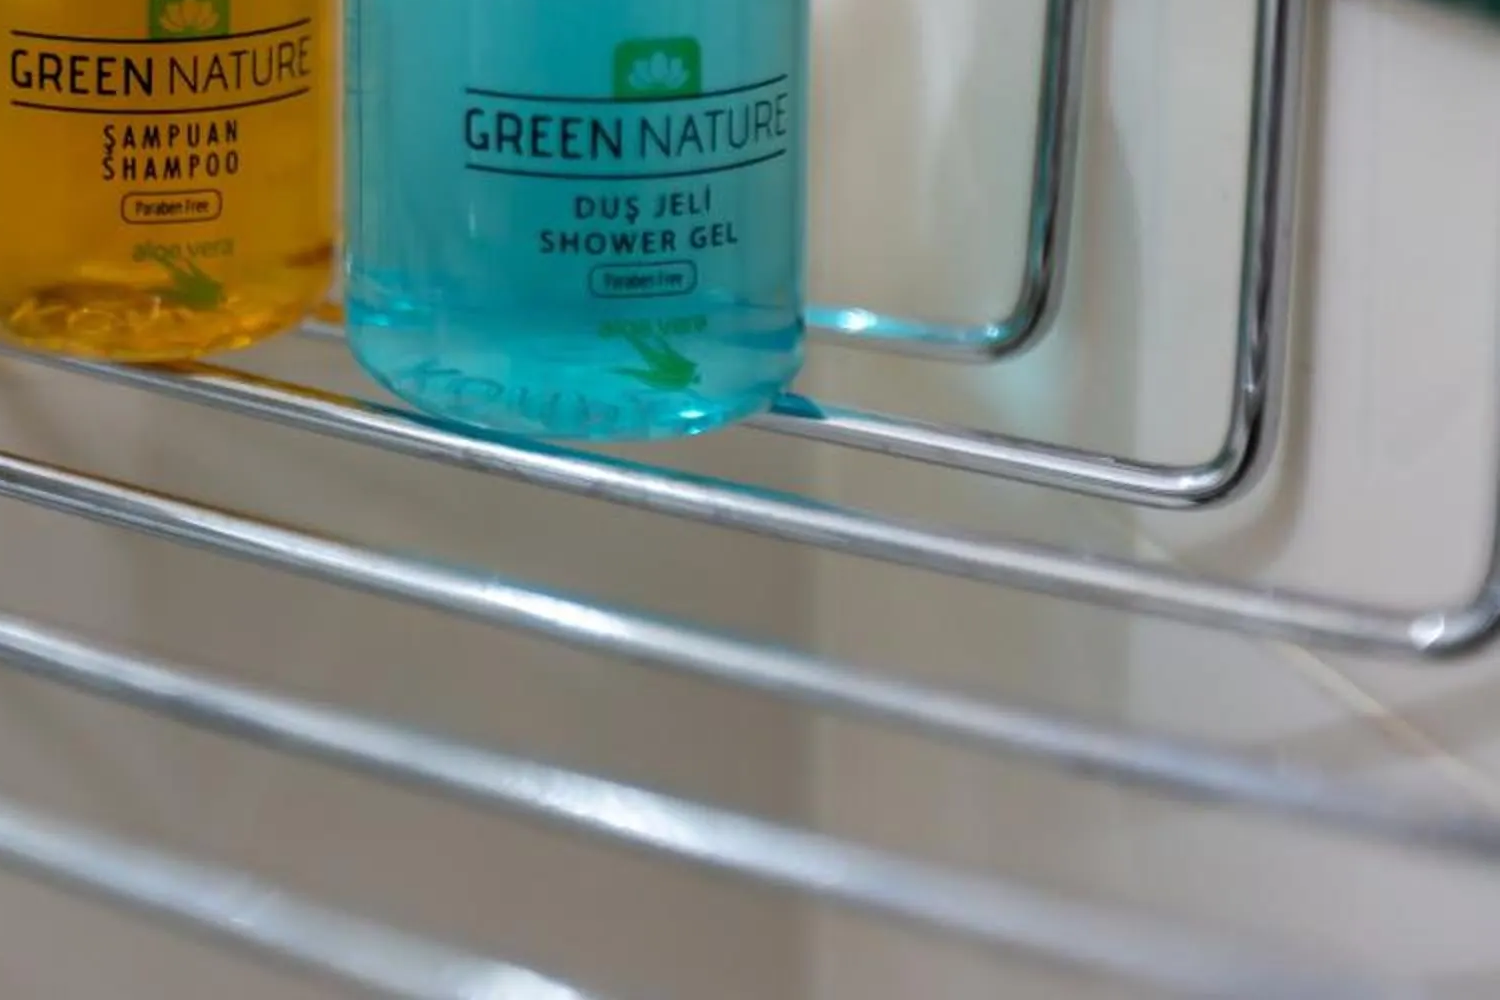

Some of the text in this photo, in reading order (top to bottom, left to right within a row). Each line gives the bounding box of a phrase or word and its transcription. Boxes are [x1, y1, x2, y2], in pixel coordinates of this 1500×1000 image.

[10, 35, 312, 96] GREEN NATURE
[464, 92, 789, 160] GREEN NATURE
[102, 150, 239, 180] SHAMPOO
[574, 195, 640, 225] DUŞ
[539, 223, 739, 256] SHOWER GEL
